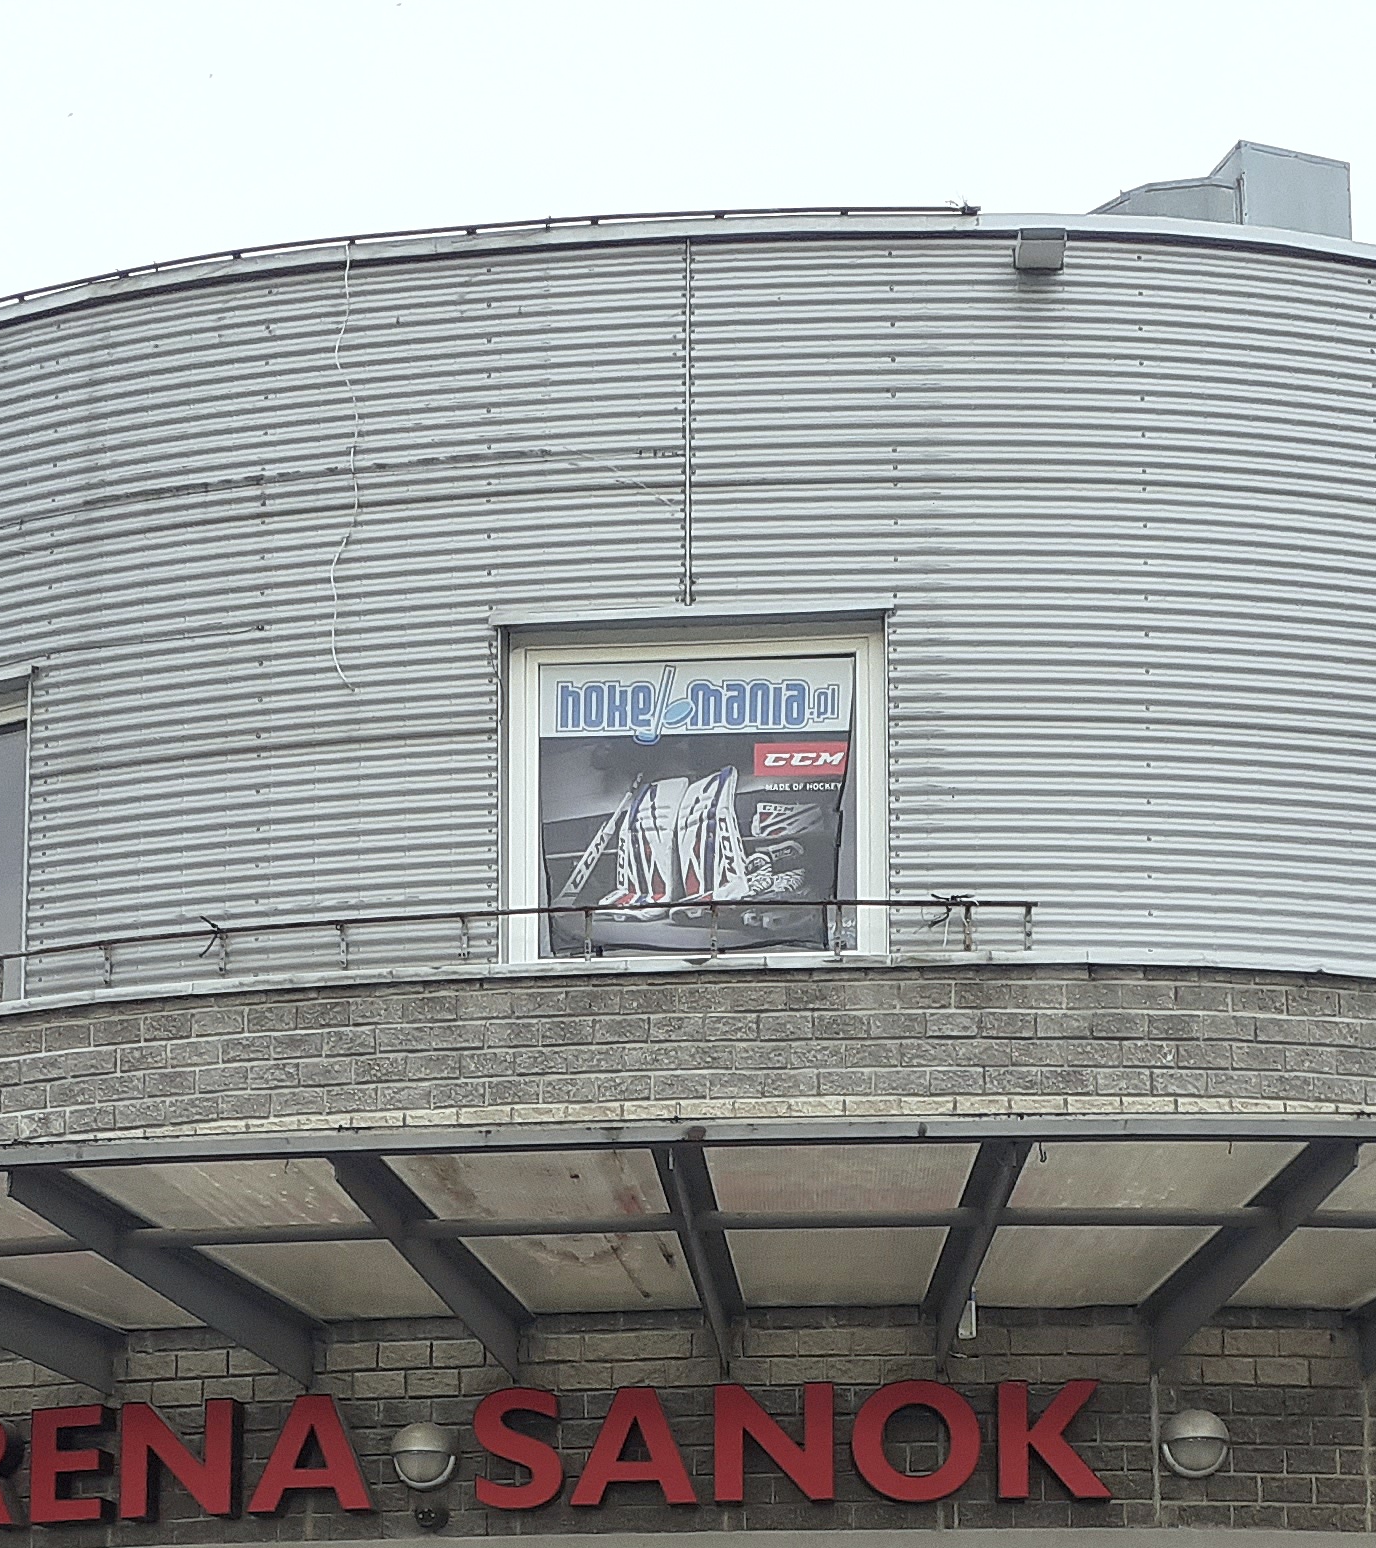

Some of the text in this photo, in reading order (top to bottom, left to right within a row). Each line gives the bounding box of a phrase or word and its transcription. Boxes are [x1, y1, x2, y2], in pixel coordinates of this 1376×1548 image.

[763, 751, 845, 767] CCM
[765, 782, 791, 792] MADE
[806, 781, 843, 792] HOCKEY
[572, 834, 606, 890] CCM
[472, 1378, 1114, 1511] SANOK
